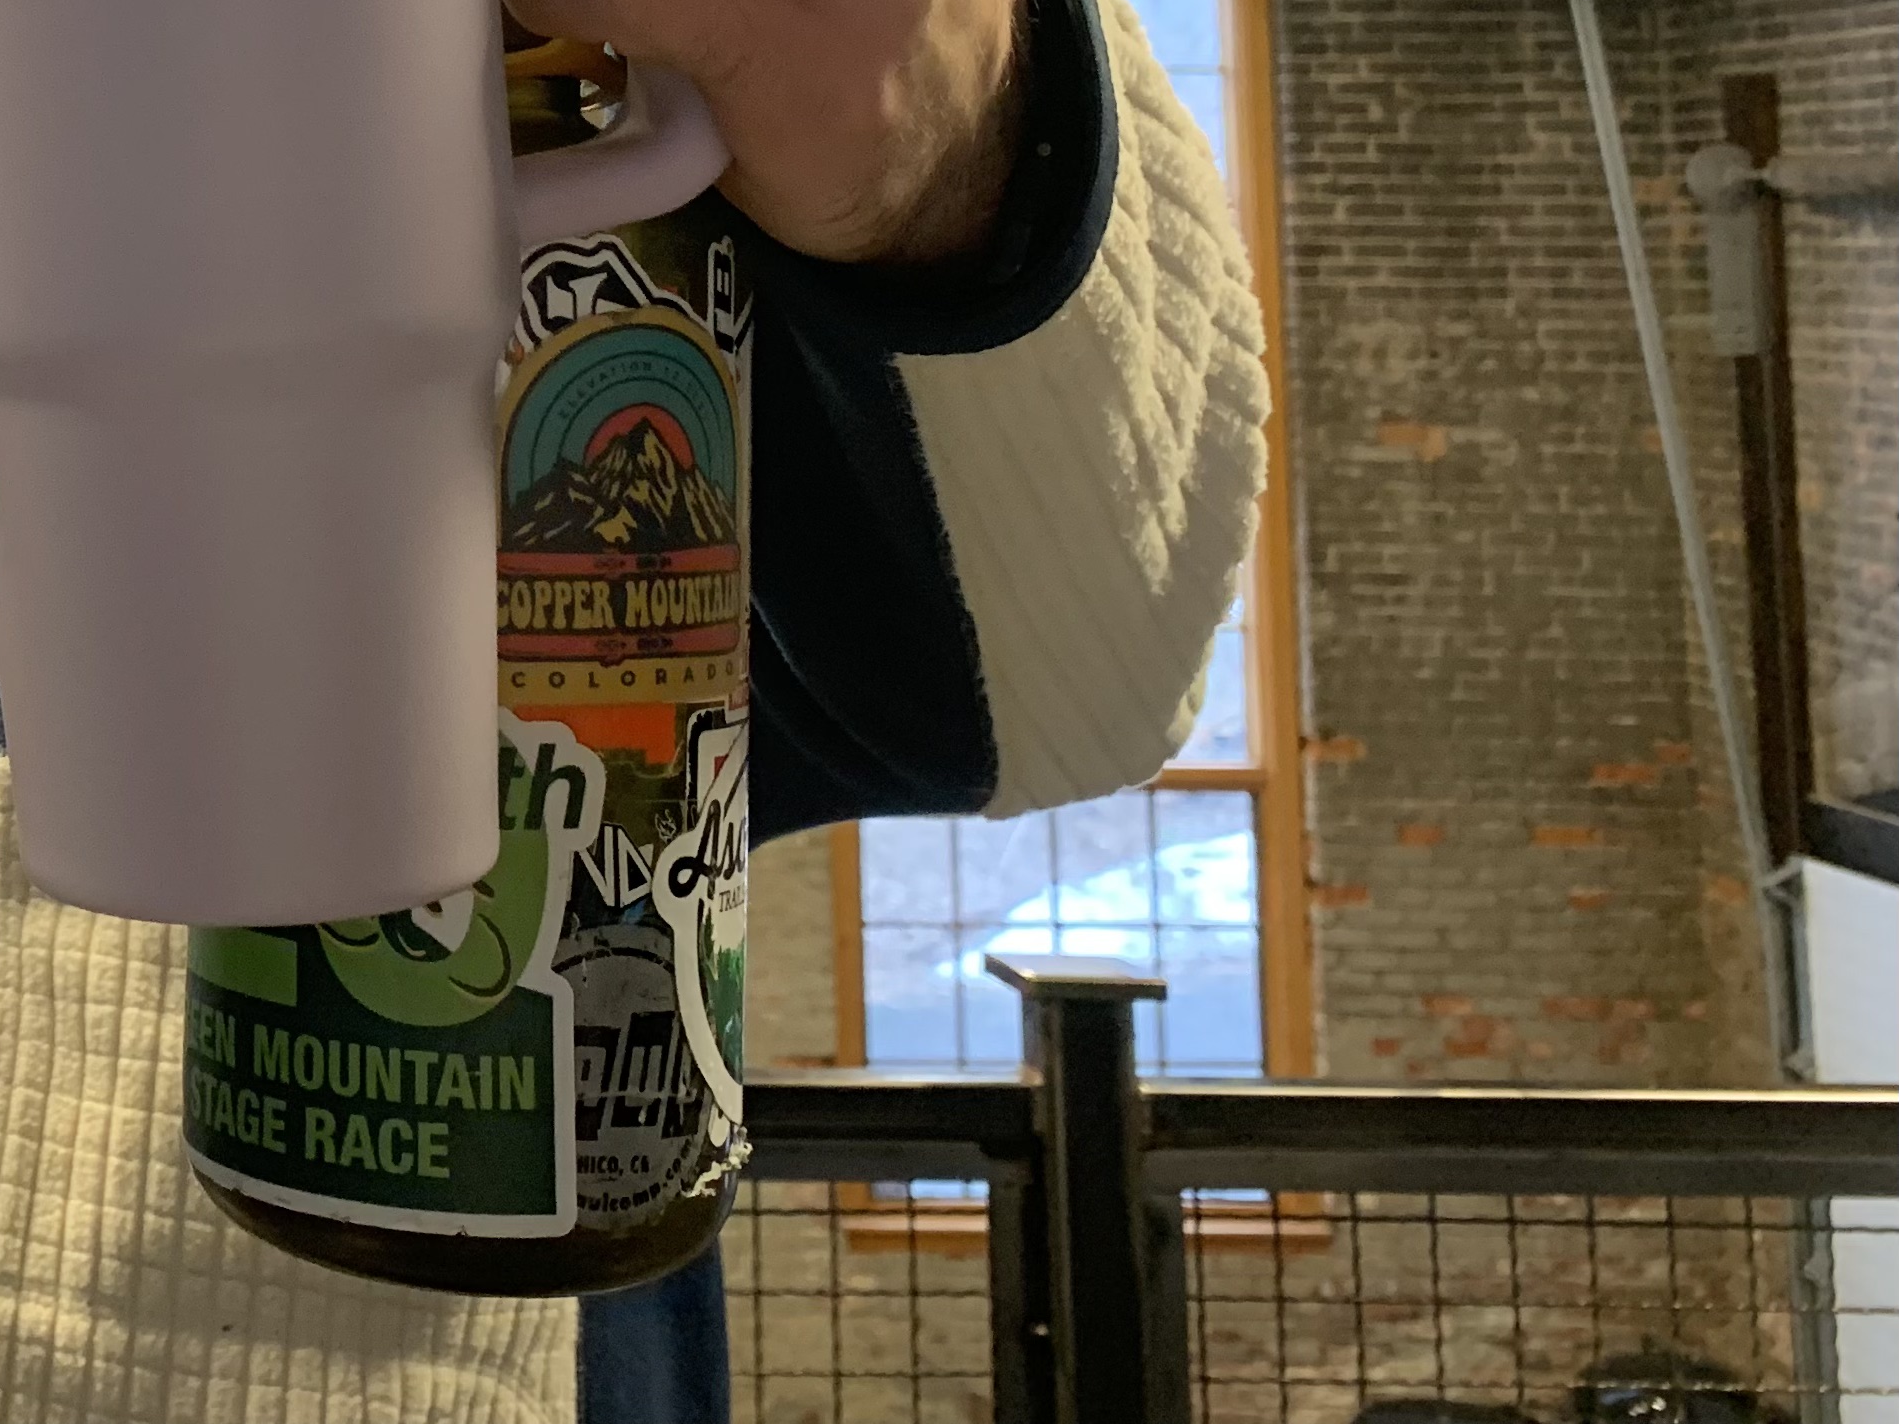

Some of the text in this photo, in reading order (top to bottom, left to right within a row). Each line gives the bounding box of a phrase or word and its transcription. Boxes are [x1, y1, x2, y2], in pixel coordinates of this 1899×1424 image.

[511, 659, 733, 689] COLORADO
[254, 1022, 535, 1111] MOUNTAIN
[190, 1065, 450, 1178] STAGE RACE
